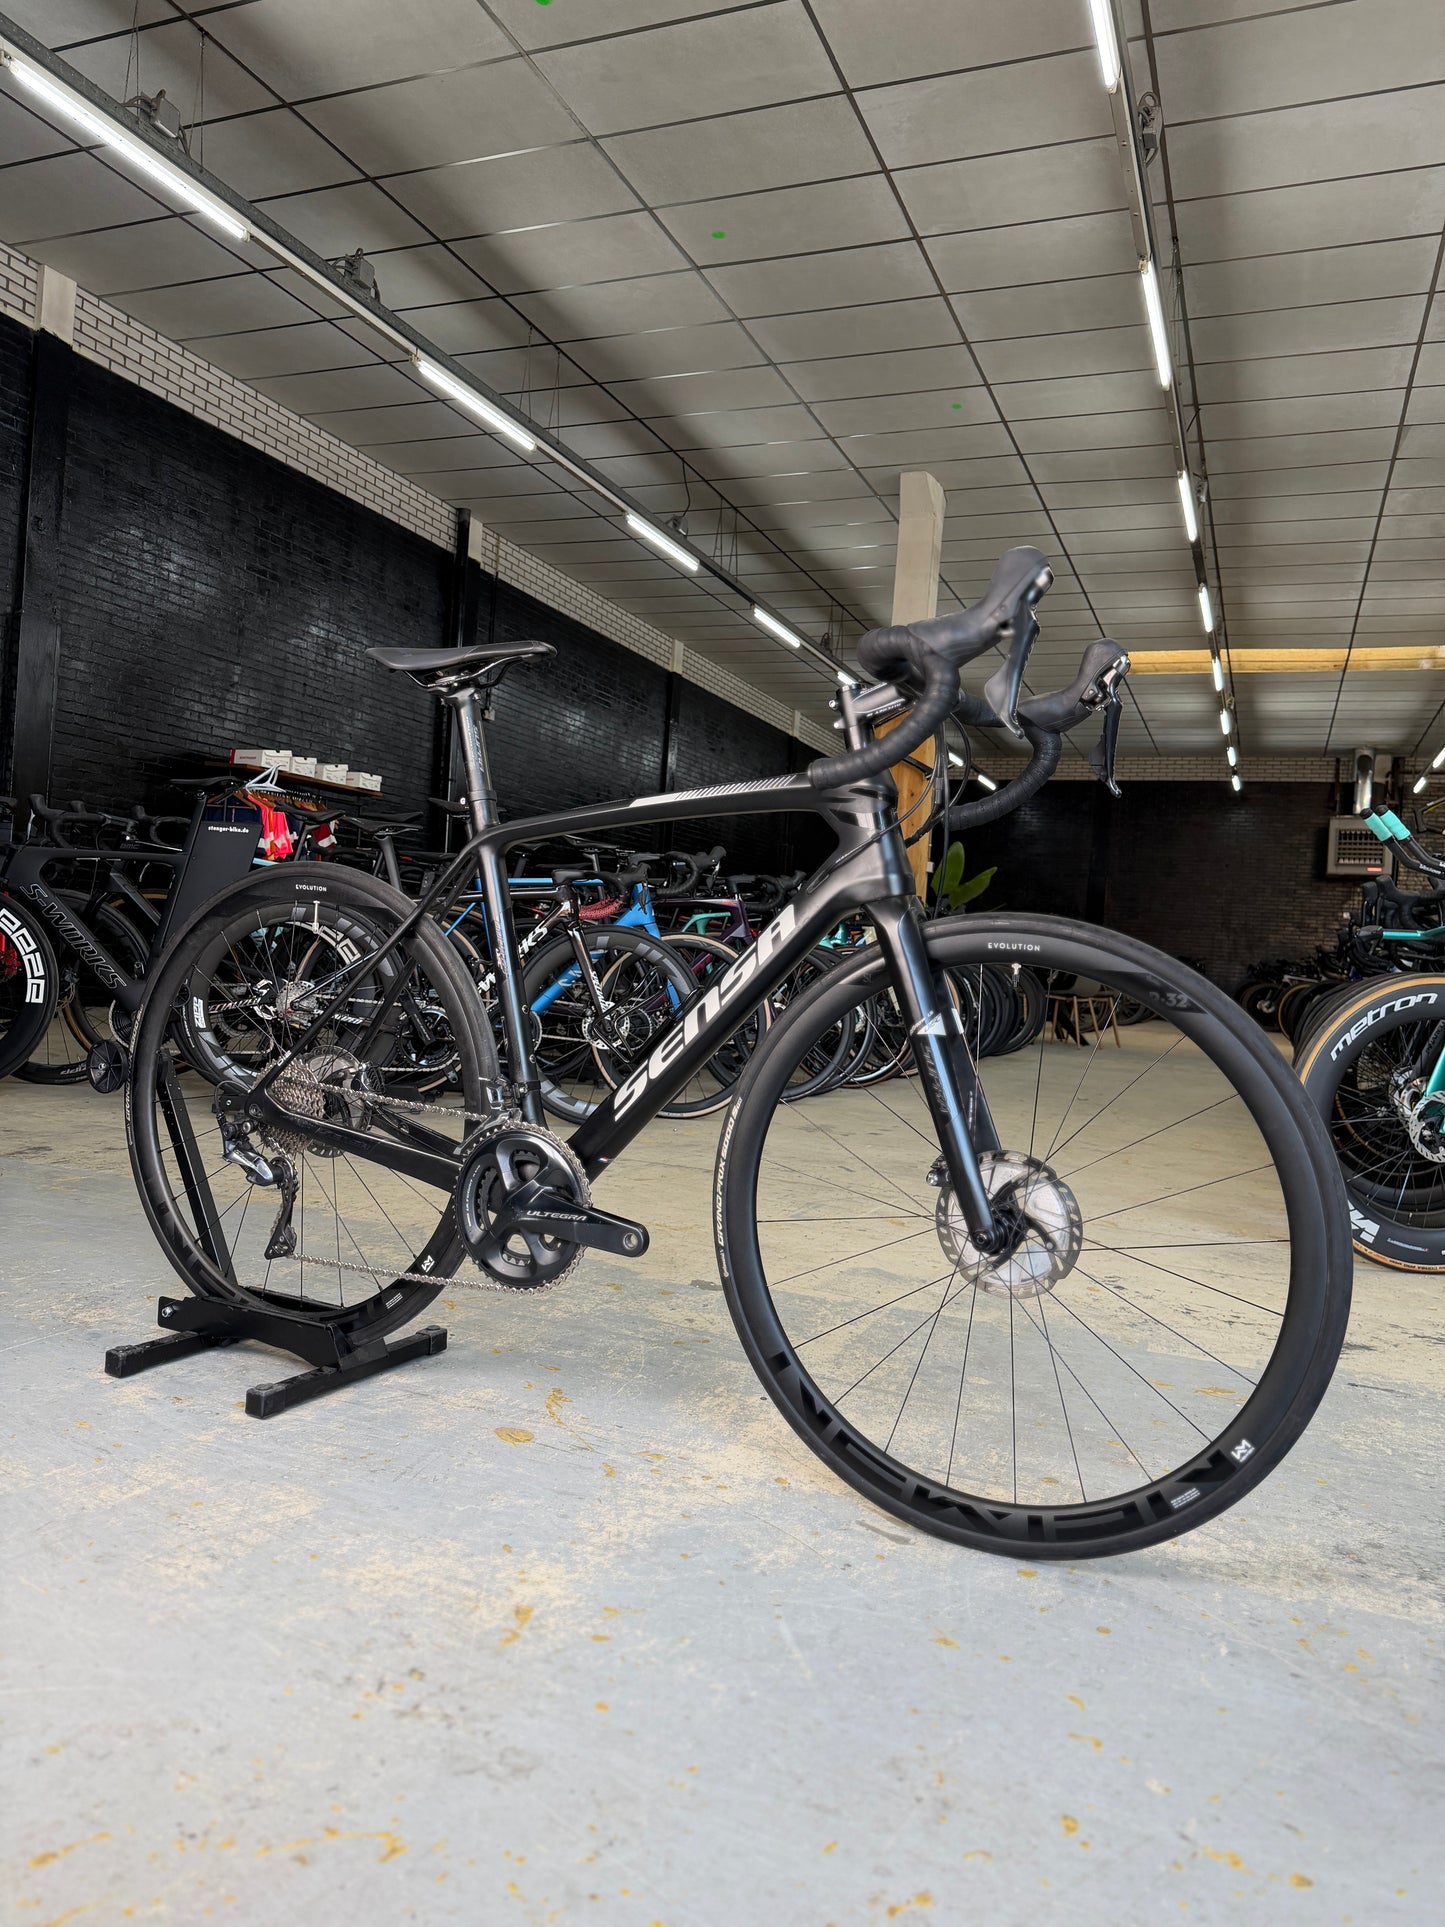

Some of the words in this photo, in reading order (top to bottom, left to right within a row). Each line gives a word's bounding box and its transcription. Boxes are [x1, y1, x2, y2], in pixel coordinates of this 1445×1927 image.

[295, 883, 327, 892] EVOLUTION
[20, 884, 127, 989] S-WORKS
[987, 942, 1041, 952] EVOLUTION
[1330, 993, 1438, 1061] metron
[721, 1118, 735, 1159] 5000
[717, 1161, 727, 1195] PRIX
[527, 1210, 587, 1221] ULTEGRA
[716, 1196, 726, 1247] GRAND
